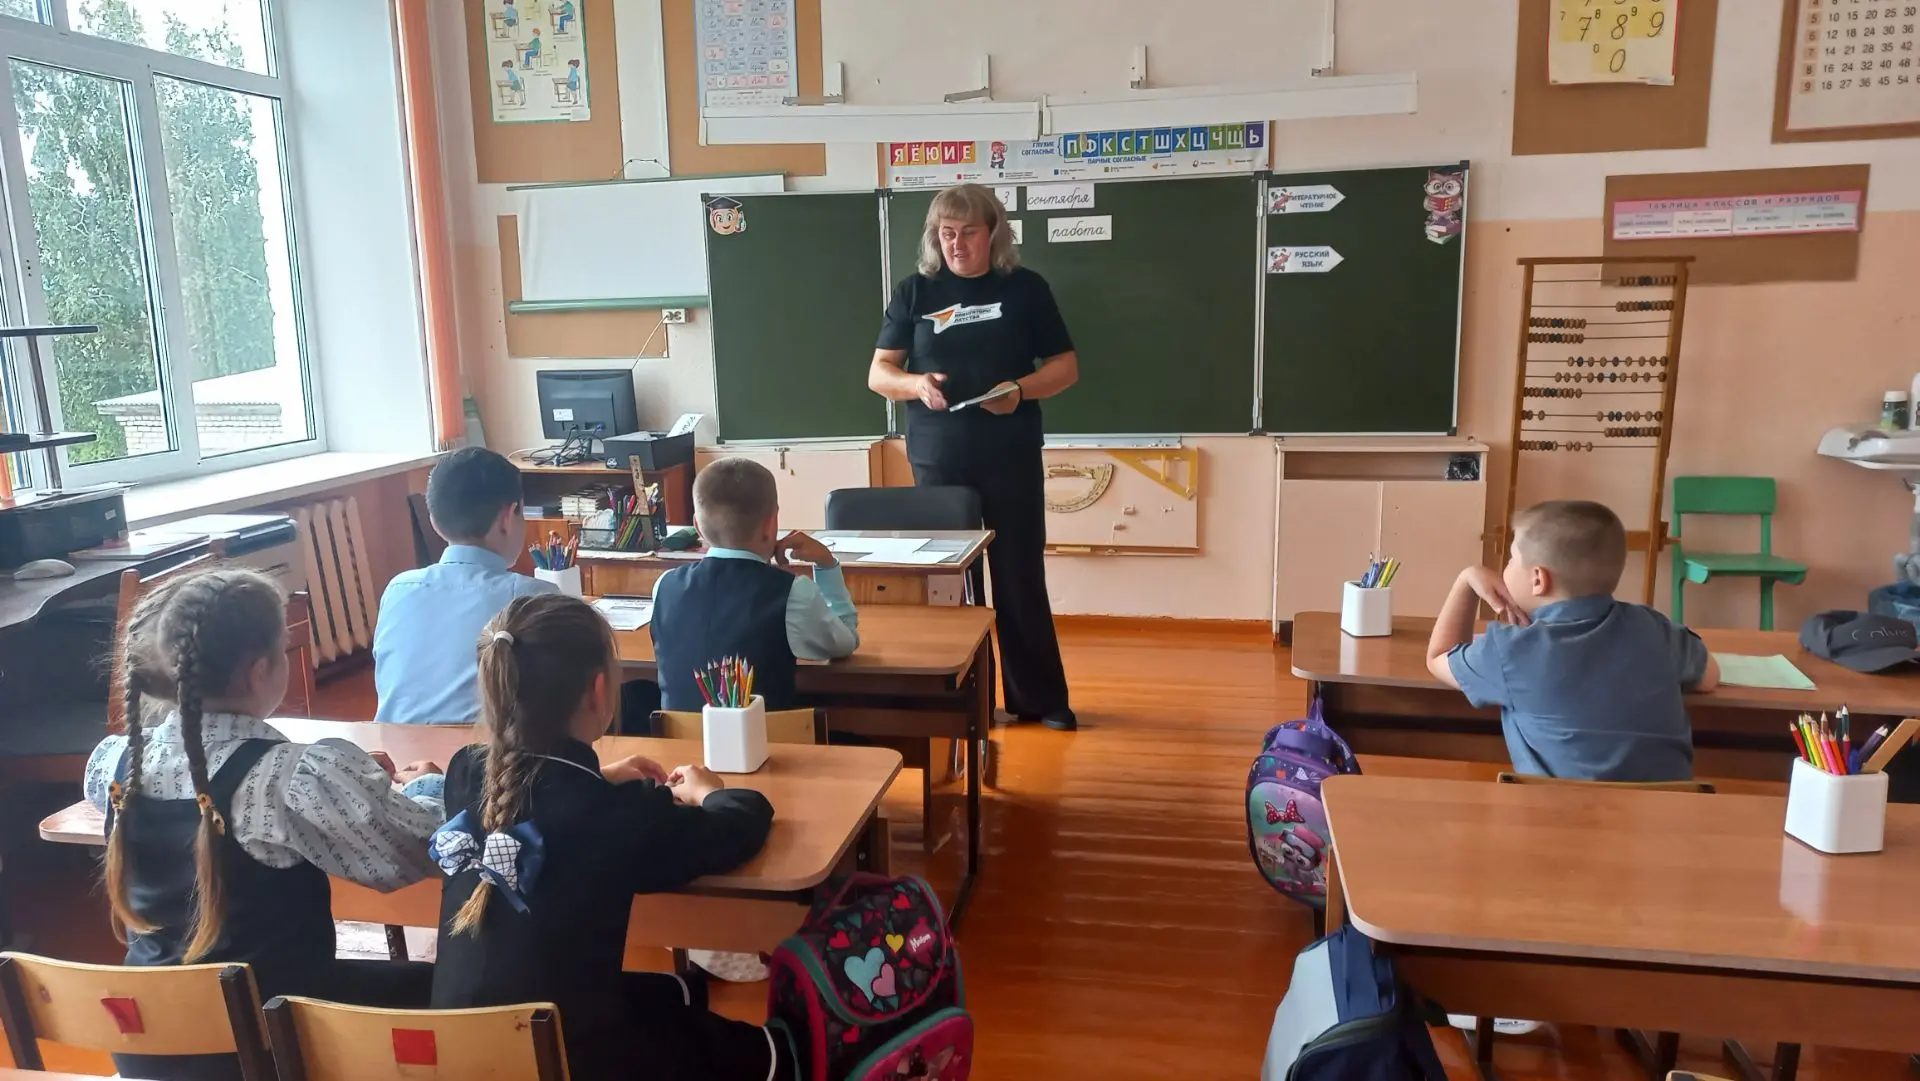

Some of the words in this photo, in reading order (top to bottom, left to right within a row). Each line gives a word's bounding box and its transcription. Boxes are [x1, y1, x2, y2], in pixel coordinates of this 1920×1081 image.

[1578, 16, 1592, 41] 7
[1594, 8, 1601, 19] 8
[1610, 14, 1628, 40] 8
[1631, 6, 1638, 16] 9
[1647, 11, 1665, 38] 9
[1810, 14, 1818, 24] 5
[1829, 12, 1840, 22] 10
[1847, 11, 1858, 20] 15
[1865, 10, 1878, 20] 20
[1884, 8, 1897, 18] 25
[1903, 6, 1916, 16] 30
[1808, 32, 1816, 42] 6
[1827, 30, 1838, 40] 12
[1846, 28, 1857, 38] 18
[1864, 27, 1876, 37] 24
[1882, 25, 1895, 36] 30
[1902, 24, 1914, 34] 36
[1808, 48, 1816, 56] 7
[1826, 46, 1836, 56] 14
[1844, 46, 1856, 55] 21
[1862, 44, 1874, 54] 28
[1881, 42, 1894, 52] 35
[1900, 41, 1913, 51] 42
[1592, 43, 1600, 54] 0
[1609, 48, 1626, 73] 0
[1806, 65, 1812, 75] 8
[1824, 64, 1835, 73] 16
[1842, 62, 1853, 72] 24
[1860, 61, 1873, 71] 32
[1880, 60, 1892, 70] 40
[1898, 58, 1911, 68] 48
[1804, 82, 1812, 92] 9
[1822, 80, 1832, 90] 18
[1840, 79, 1852, 90] 27
[1859, 78, 1872, 88] 36
[1878, 76, 1890, 86] 45
[1897, 75, 1910, 85] 54
[1027, 187, 1091, 209] сентября
[1290, 193, 1337, 201] ИТЕРАТУРНОЕ
[1050, 220, 1105, 243] работа
